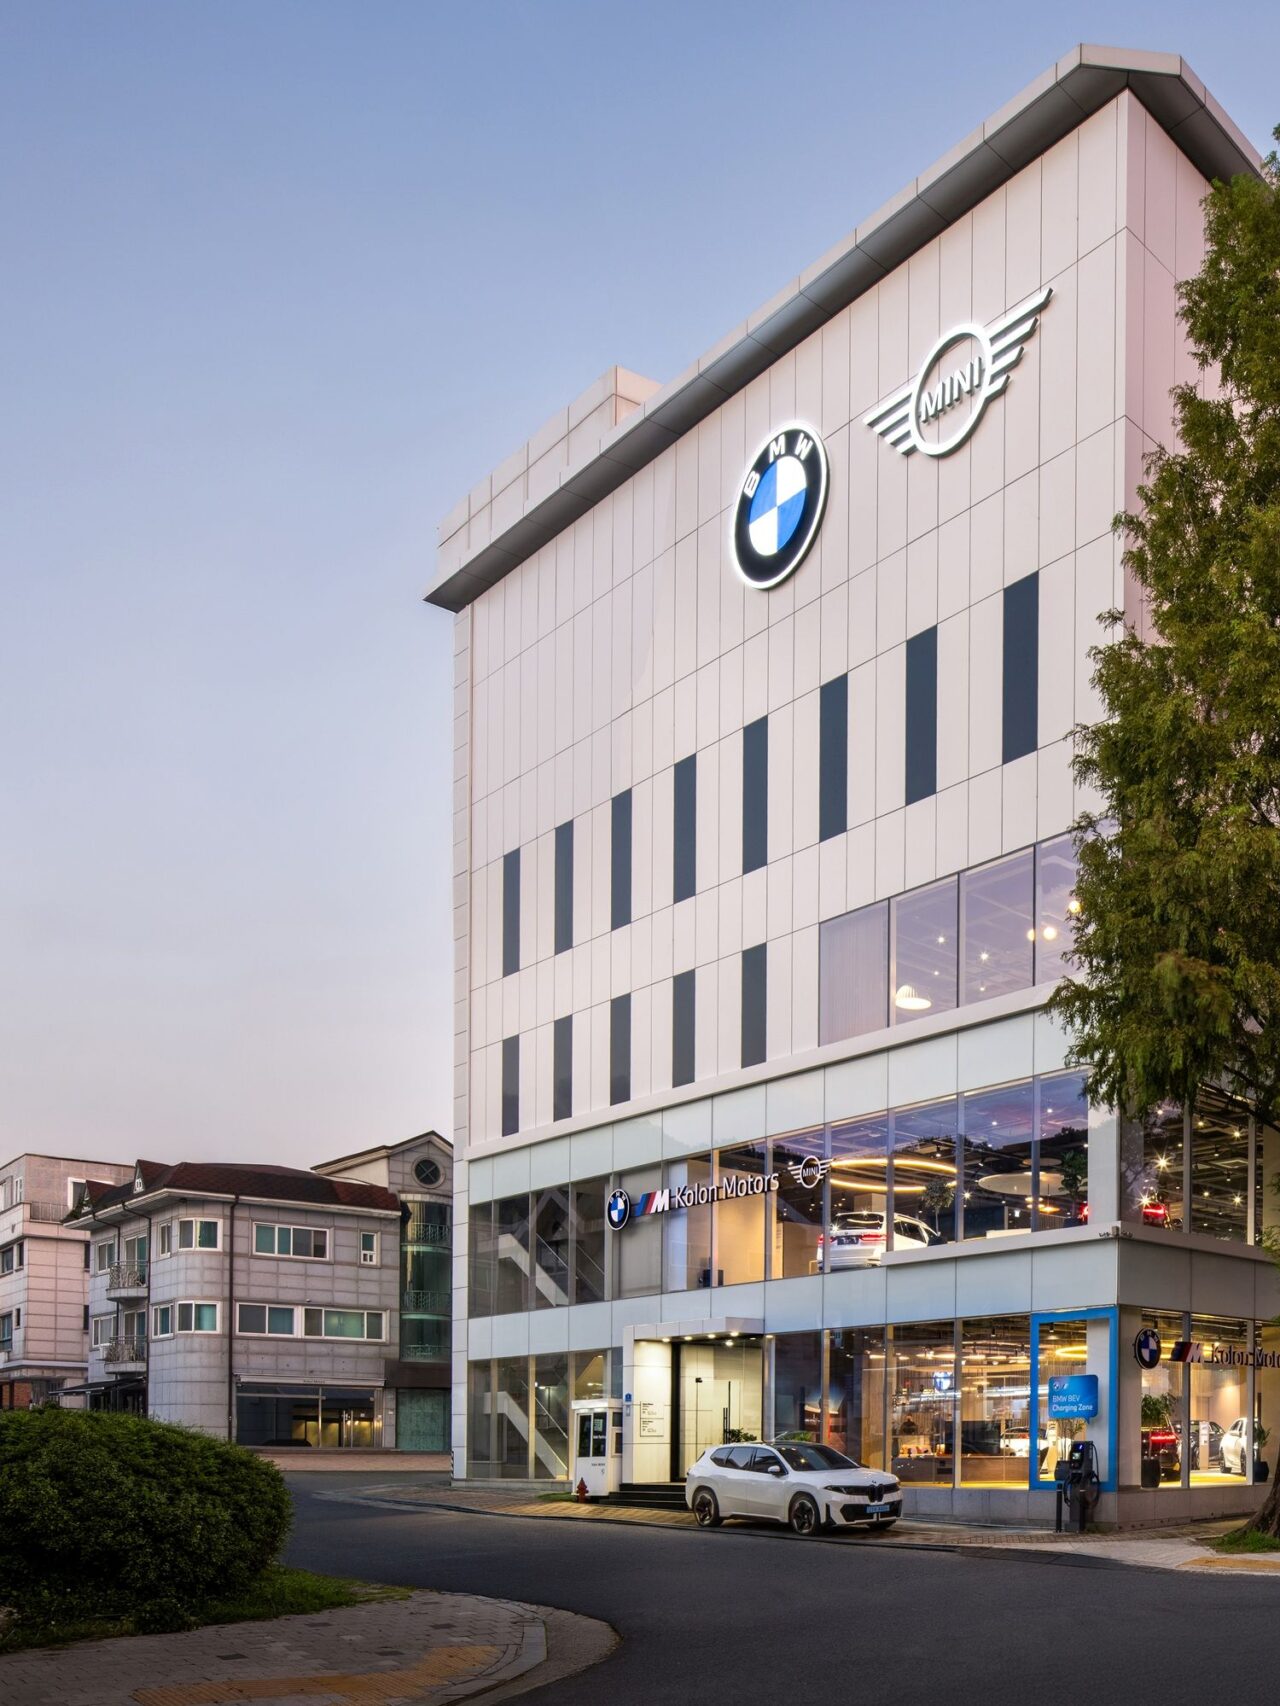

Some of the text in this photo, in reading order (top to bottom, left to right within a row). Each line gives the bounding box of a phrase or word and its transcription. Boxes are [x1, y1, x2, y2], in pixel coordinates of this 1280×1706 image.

[920, 356, 984, 423] MINI
[743, 432, 813, 498] BMW
[803, 1166, 819, 1178] MINI
[675, 1183, 718, 1208] Kolon
[723, 1172, 780, 1200] Motors
[1211, 1343, 1250, 1366] Kolon
[1052, 1403, 1093, 1412] Charging Zone
